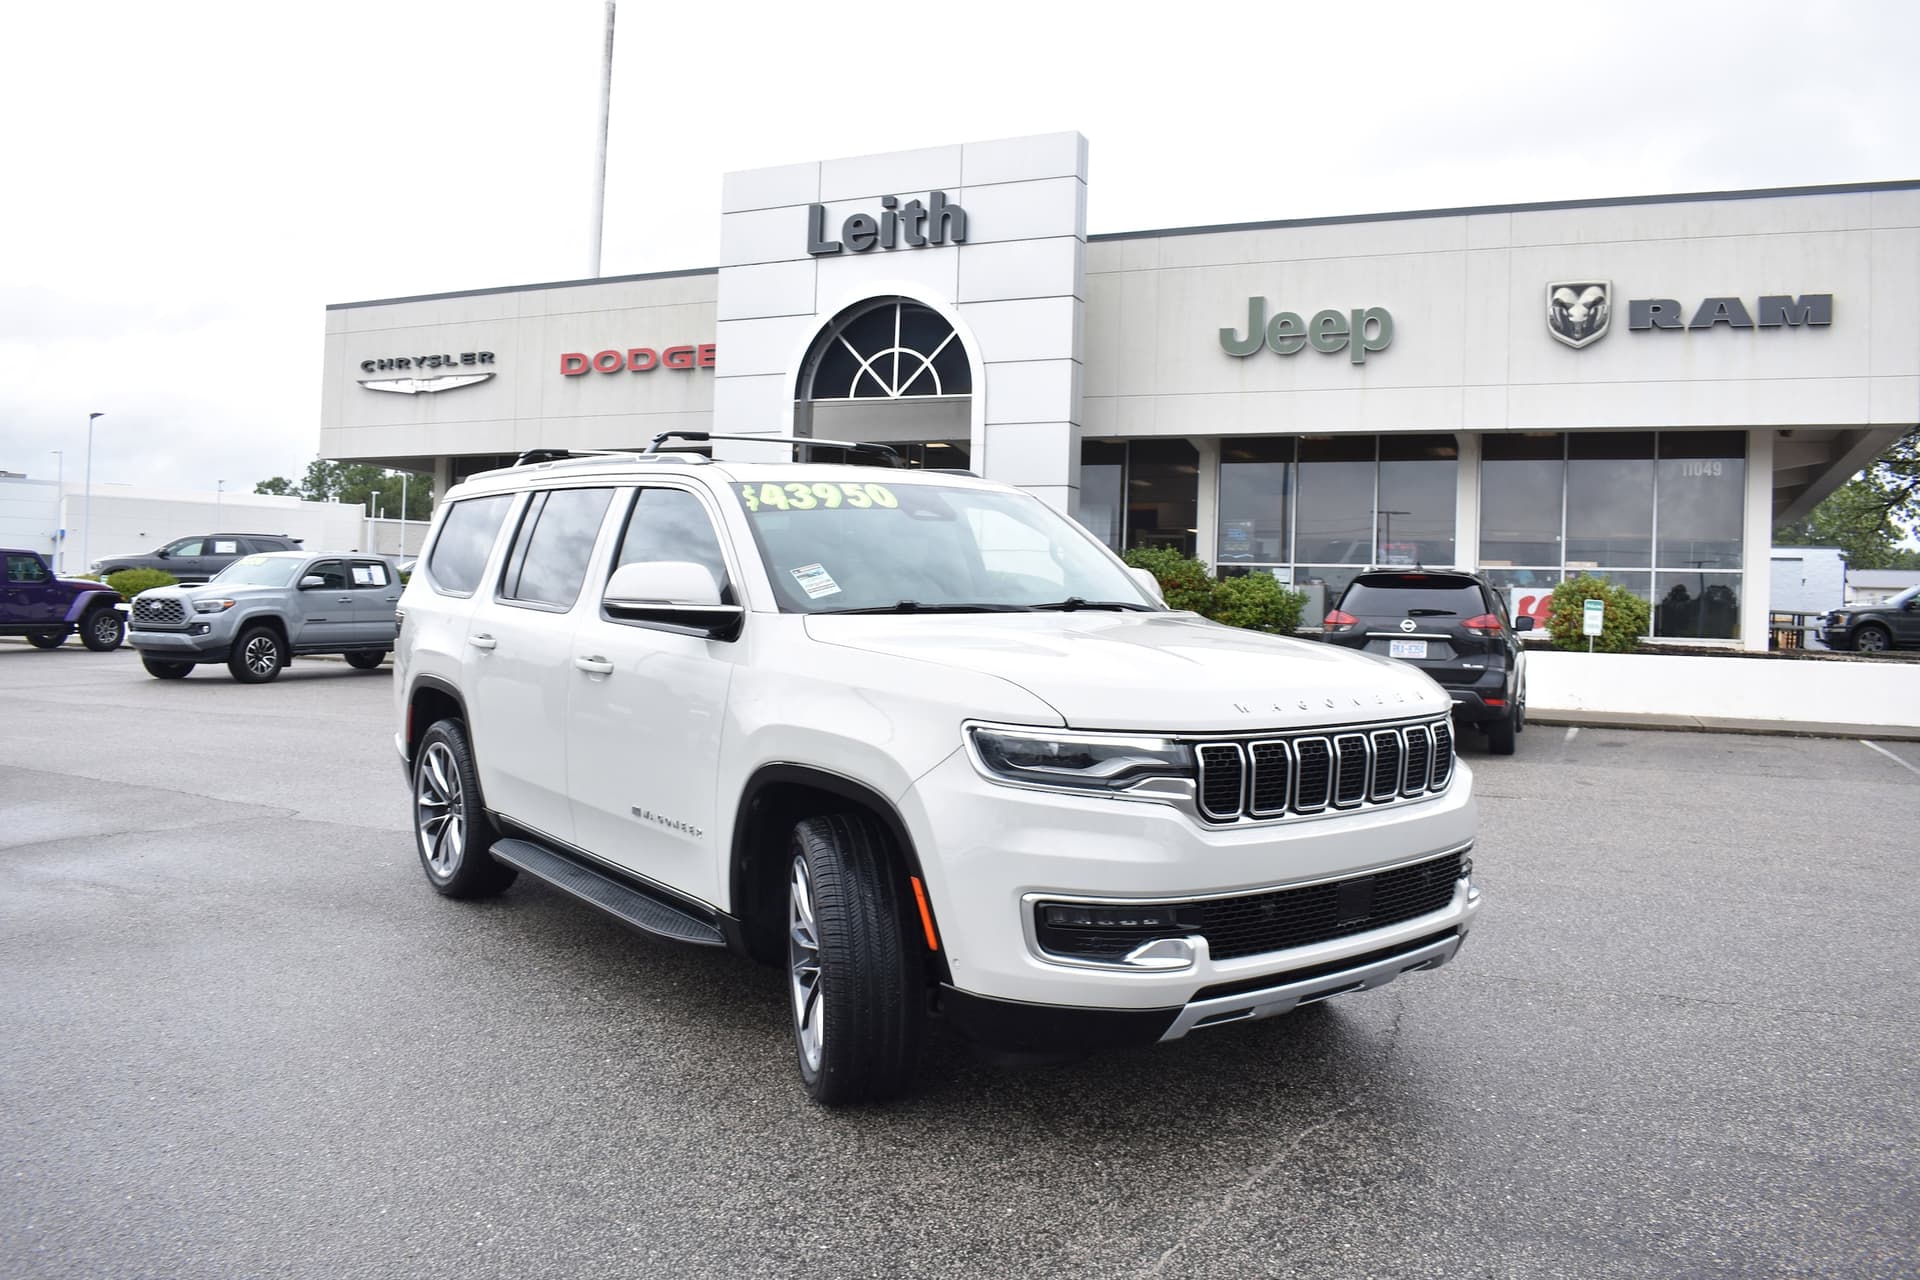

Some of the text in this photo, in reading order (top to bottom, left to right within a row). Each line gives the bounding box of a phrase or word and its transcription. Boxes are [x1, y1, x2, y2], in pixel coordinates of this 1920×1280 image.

[807, 190, 968, 257] Leith
[1629, 294, 1833, 331] RAM
[1219, 296, 1394, 365] Jeep
[360, 351, 496, 373] CHRYSLER
[560, 343, 716, 377] DODGE
[1682, 461, 1722, 477] 11049
[742, 482, 899, 512] $43950
